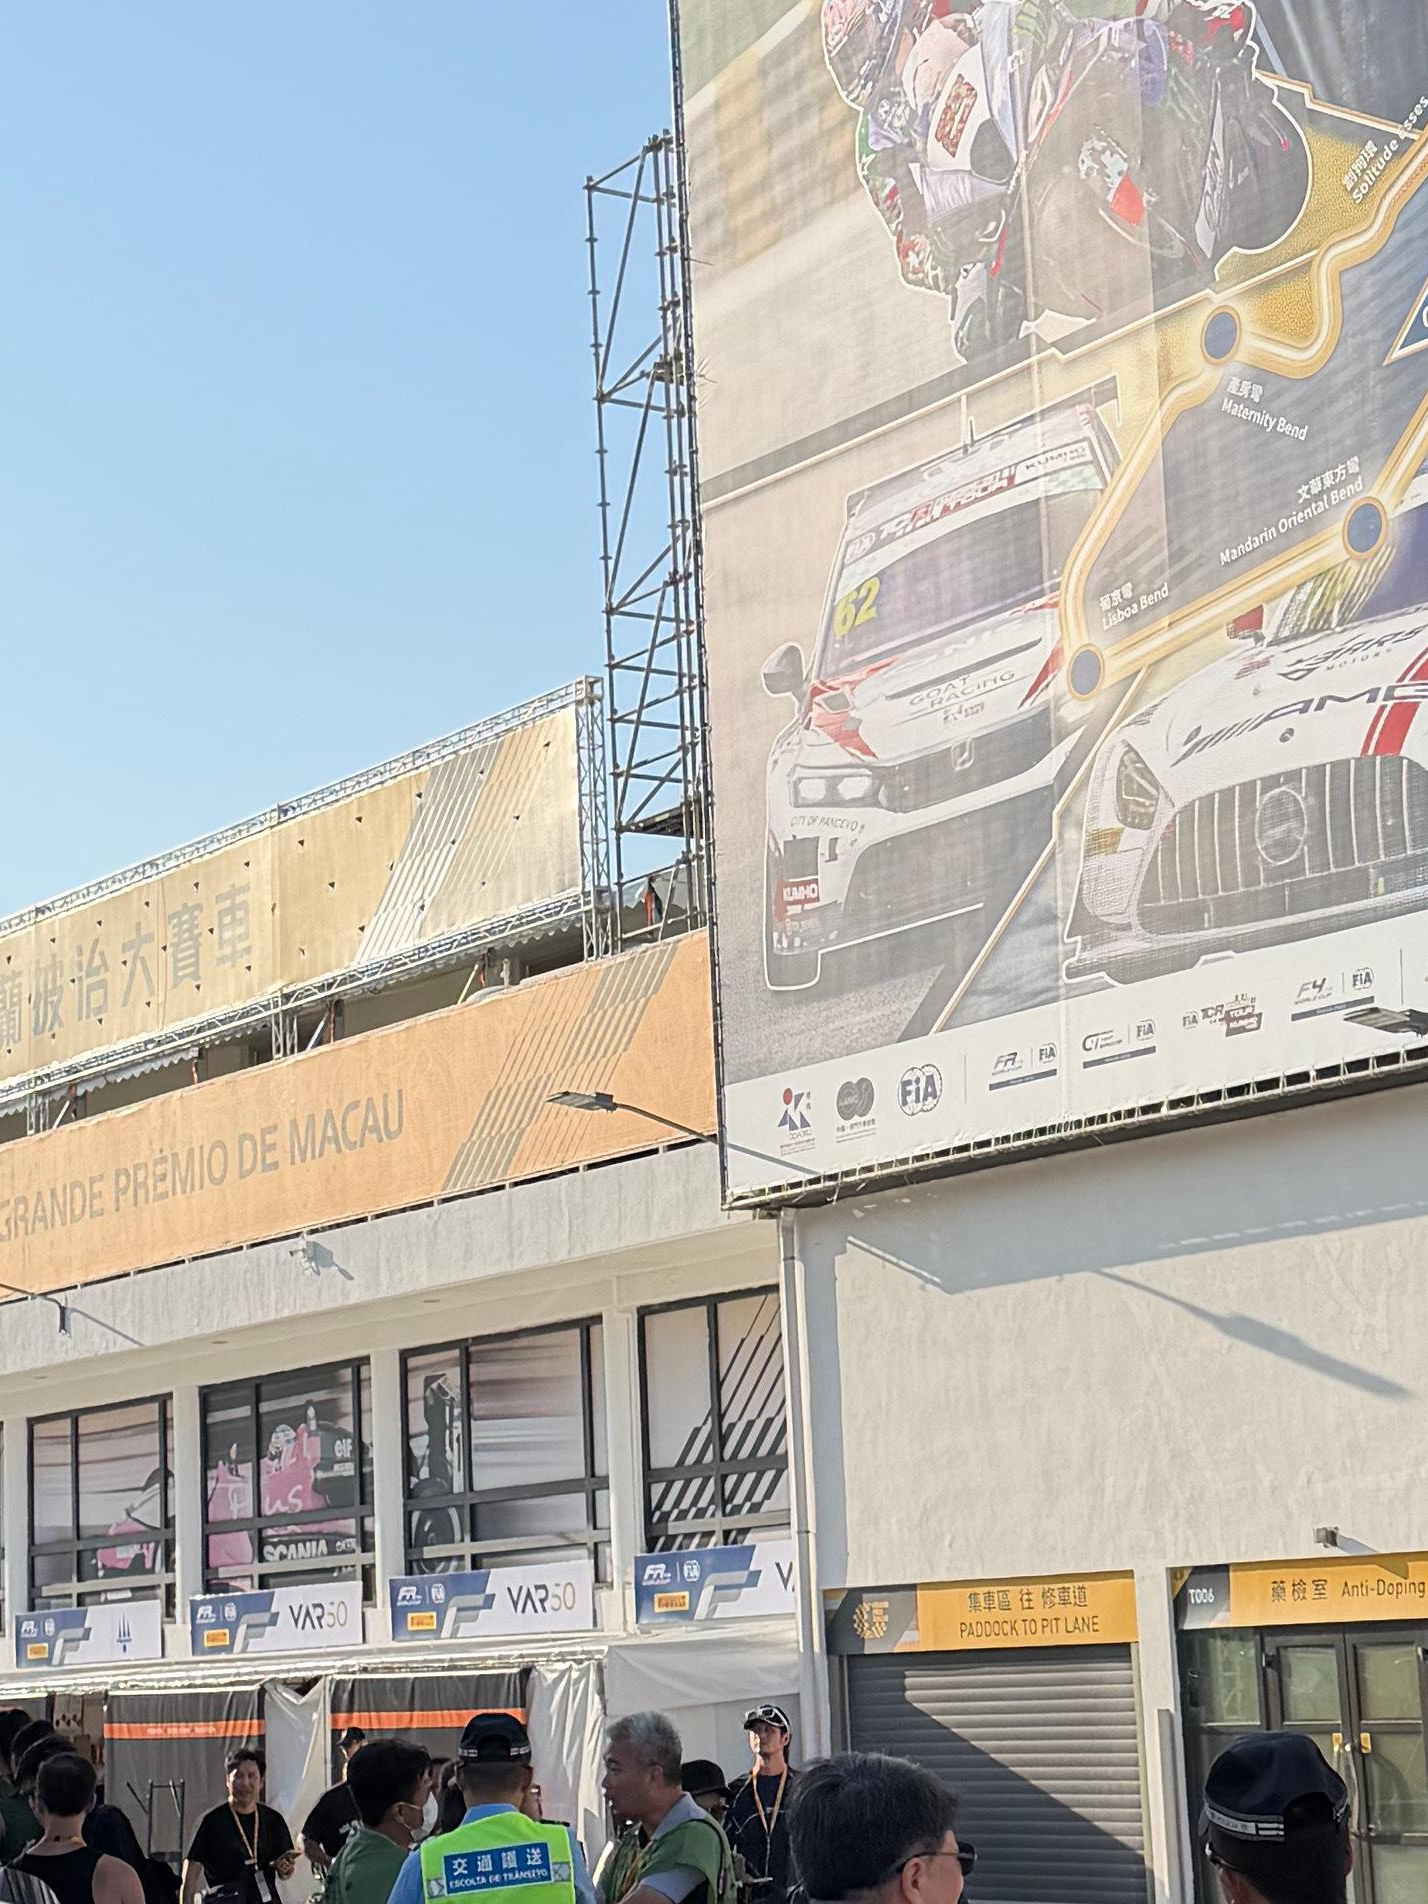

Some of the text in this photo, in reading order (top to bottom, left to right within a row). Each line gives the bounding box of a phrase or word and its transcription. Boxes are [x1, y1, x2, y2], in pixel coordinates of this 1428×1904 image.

[1352, 139, 1399, 204] Solitude
[1221, 398, 1309, 441] Maternity Bend
[1220, 476, 1363, 565] Mandarin Oriental Bend
[833, 577, 881, 637] 62
[1102, 582, 1169, 631] Lisboa Bend
[909, 675, 970, 707] GOAT
[930, 670, 1016, 708] RACING
[237, 1133, 279, 1177] DE
[288, 1089, 406, 1165] MACAU
[263, 1539, 328, 1562] SCANIA
[968, 1584, 1088, 1614] 集車區 往 修車道
[1188, 1588, 1215, 1604] T006
[1271, 1579, 1328, 1602] 藥檢室
[1341, 1577, 1426, 1599] Anti-Doping
[959, 1615, 1100, 1639] PADDOCK TO PIT LANE
[452, 1848, 544, 1876] 交通護送
[449, 1875, 487, 1889] ESCOLTA
[489, 1874, 502, 1884] DE
